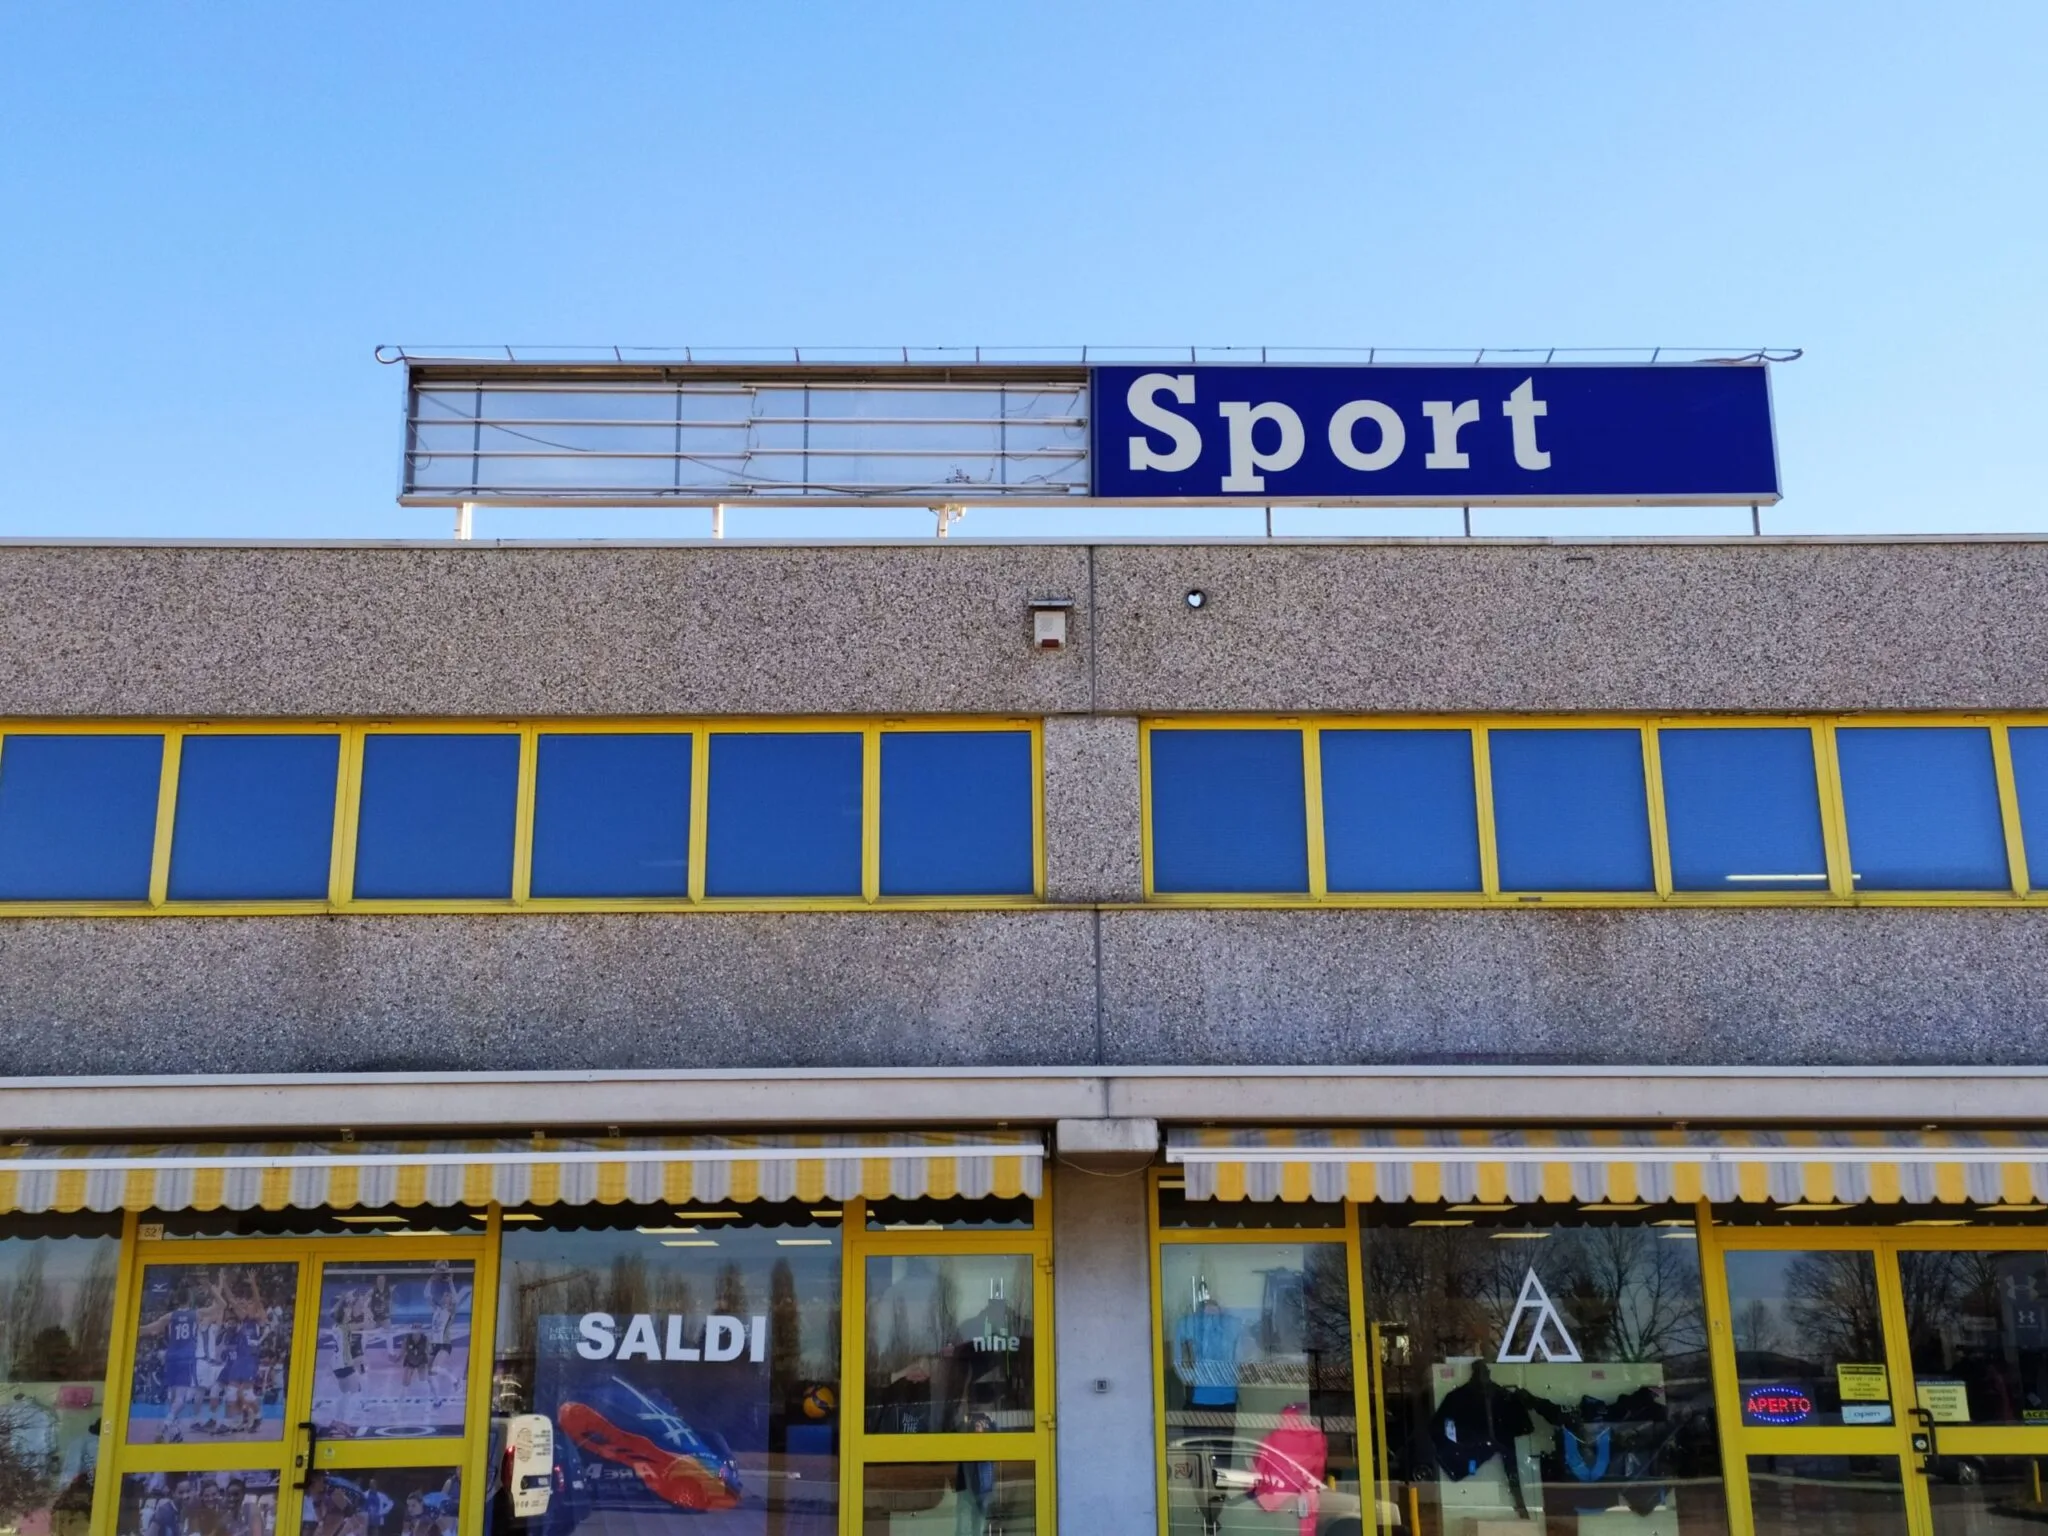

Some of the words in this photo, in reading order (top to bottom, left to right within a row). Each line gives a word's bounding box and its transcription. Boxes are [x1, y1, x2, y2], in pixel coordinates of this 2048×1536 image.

[1127, 373, 1552, 492] Sport
[576, 1312, 766, 1361] SALDI
[1747, 1397, 1811, 1413] APERTO
